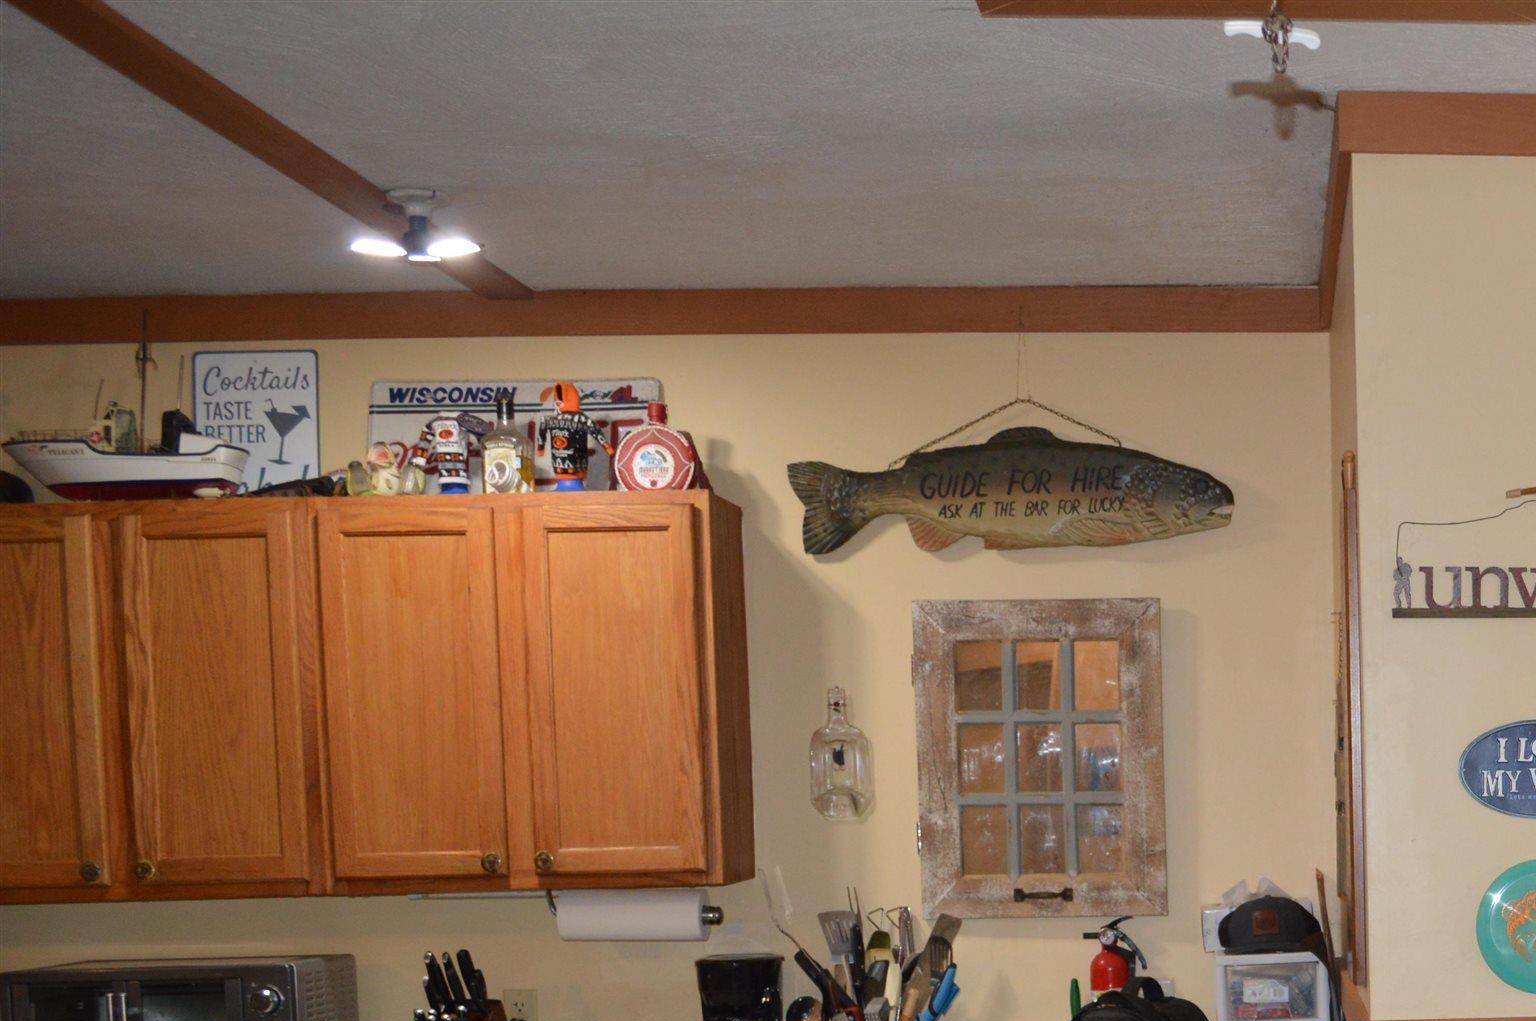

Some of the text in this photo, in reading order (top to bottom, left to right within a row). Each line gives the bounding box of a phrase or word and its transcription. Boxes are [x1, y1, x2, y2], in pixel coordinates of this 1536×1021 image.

[203, 366, 310, 396] Cocktails
[388, 386, 517, 404] WISCONSIN
[204, 400, 253, 421] TASTE
[205, 425, 266, 443] BETTER
[920, 465, 1124, 500] GUIDE FOR HIRE
[938, 496, 1126, 519] ASK AT THE BAR FOR LUCKY
[1497, 737, 1508, 763] I
[1481, 769, 1521, 797] MY
